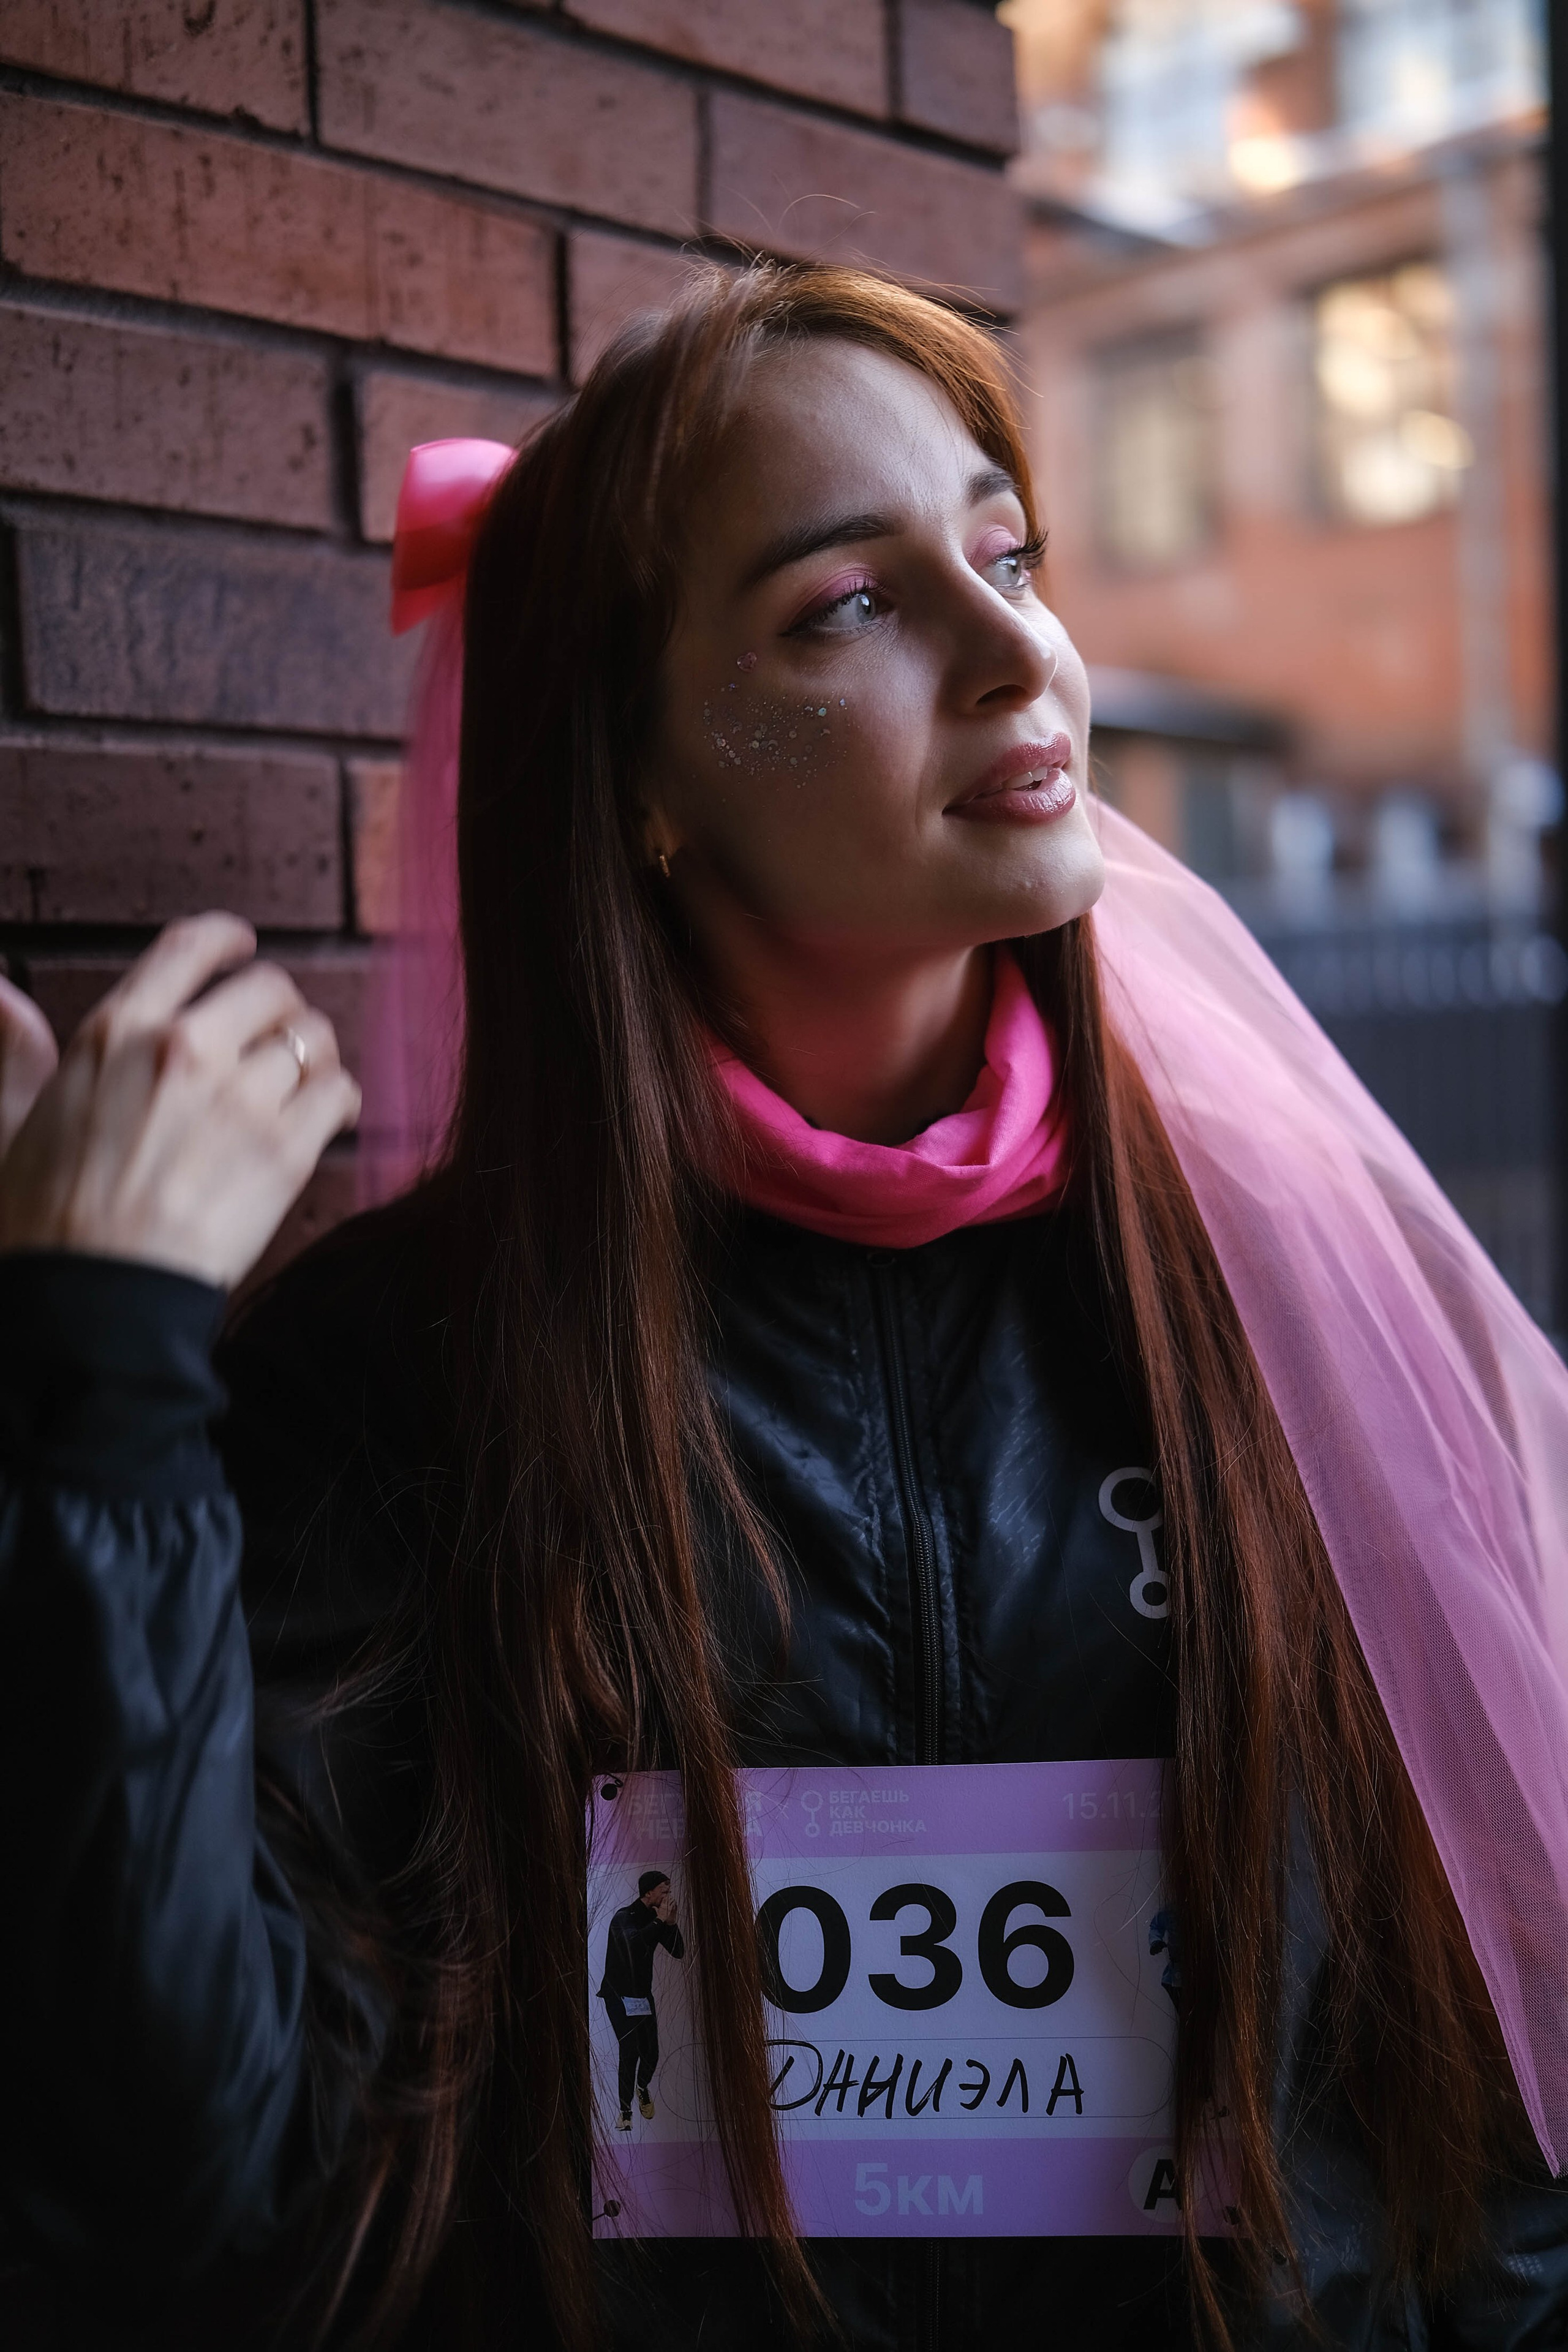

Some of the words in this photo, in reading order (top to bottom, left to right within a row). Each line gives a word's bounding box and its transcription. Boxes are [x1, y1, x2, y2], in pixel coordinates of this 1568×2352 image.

[829, 1790, 910, 1804] БЕГАЕШЬ
[1063, 1791, 1164, 1820] 15.11.2
[829, 1805, 866, 1819] КАК
[828, 1819, 927, 1837] ДЕВЧОНКА
[755, 1880, 1075, 2014] 036
